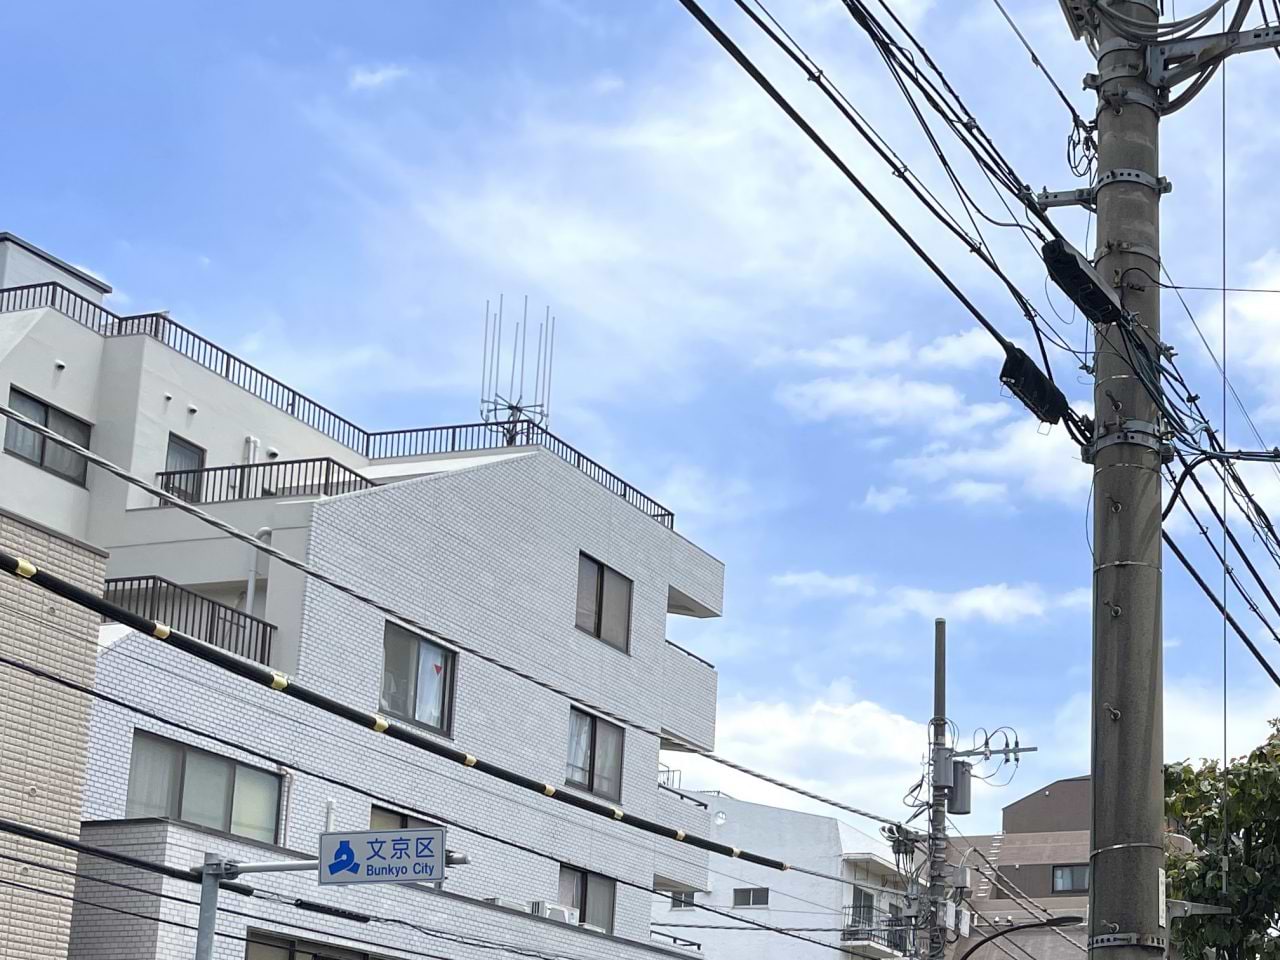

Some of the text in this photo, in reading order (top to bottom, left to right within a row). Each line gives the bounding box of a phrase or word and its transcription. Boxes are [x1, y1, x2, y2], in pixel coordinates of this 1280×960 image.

[366, 837, 435, 861] 文京区
[366, 863, 435, 878] Bunkyo City
